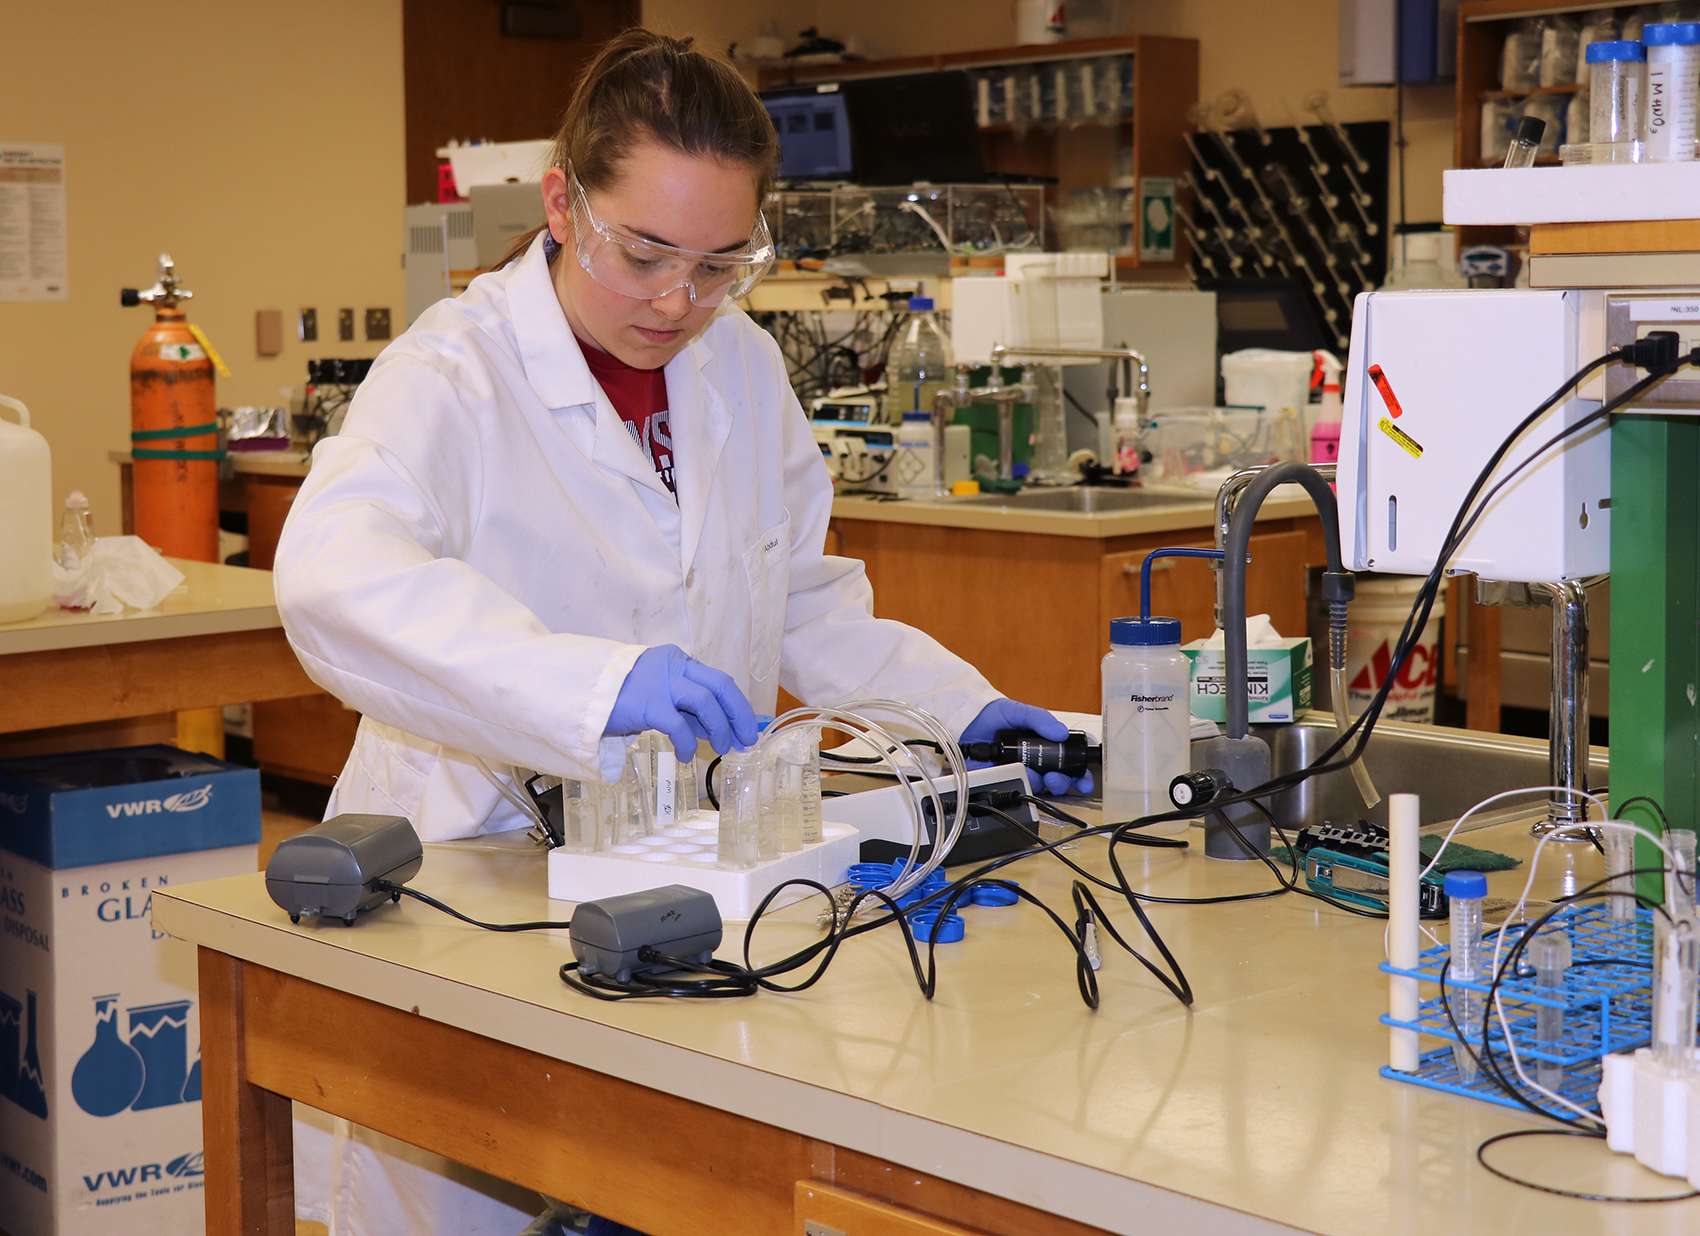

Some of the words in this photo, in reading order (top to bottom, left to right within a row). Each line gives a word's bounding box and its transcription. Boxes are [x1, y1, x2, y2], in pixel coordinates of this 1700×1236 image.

[1651, 83, 1664, 95] M
[1131, 694, 1175, 702] Fisherbrand
[106, 799, 162, 818] VWR
[62, 875, 169, 898] BROKEN
[83, 1163, 163, 1193] VWR
